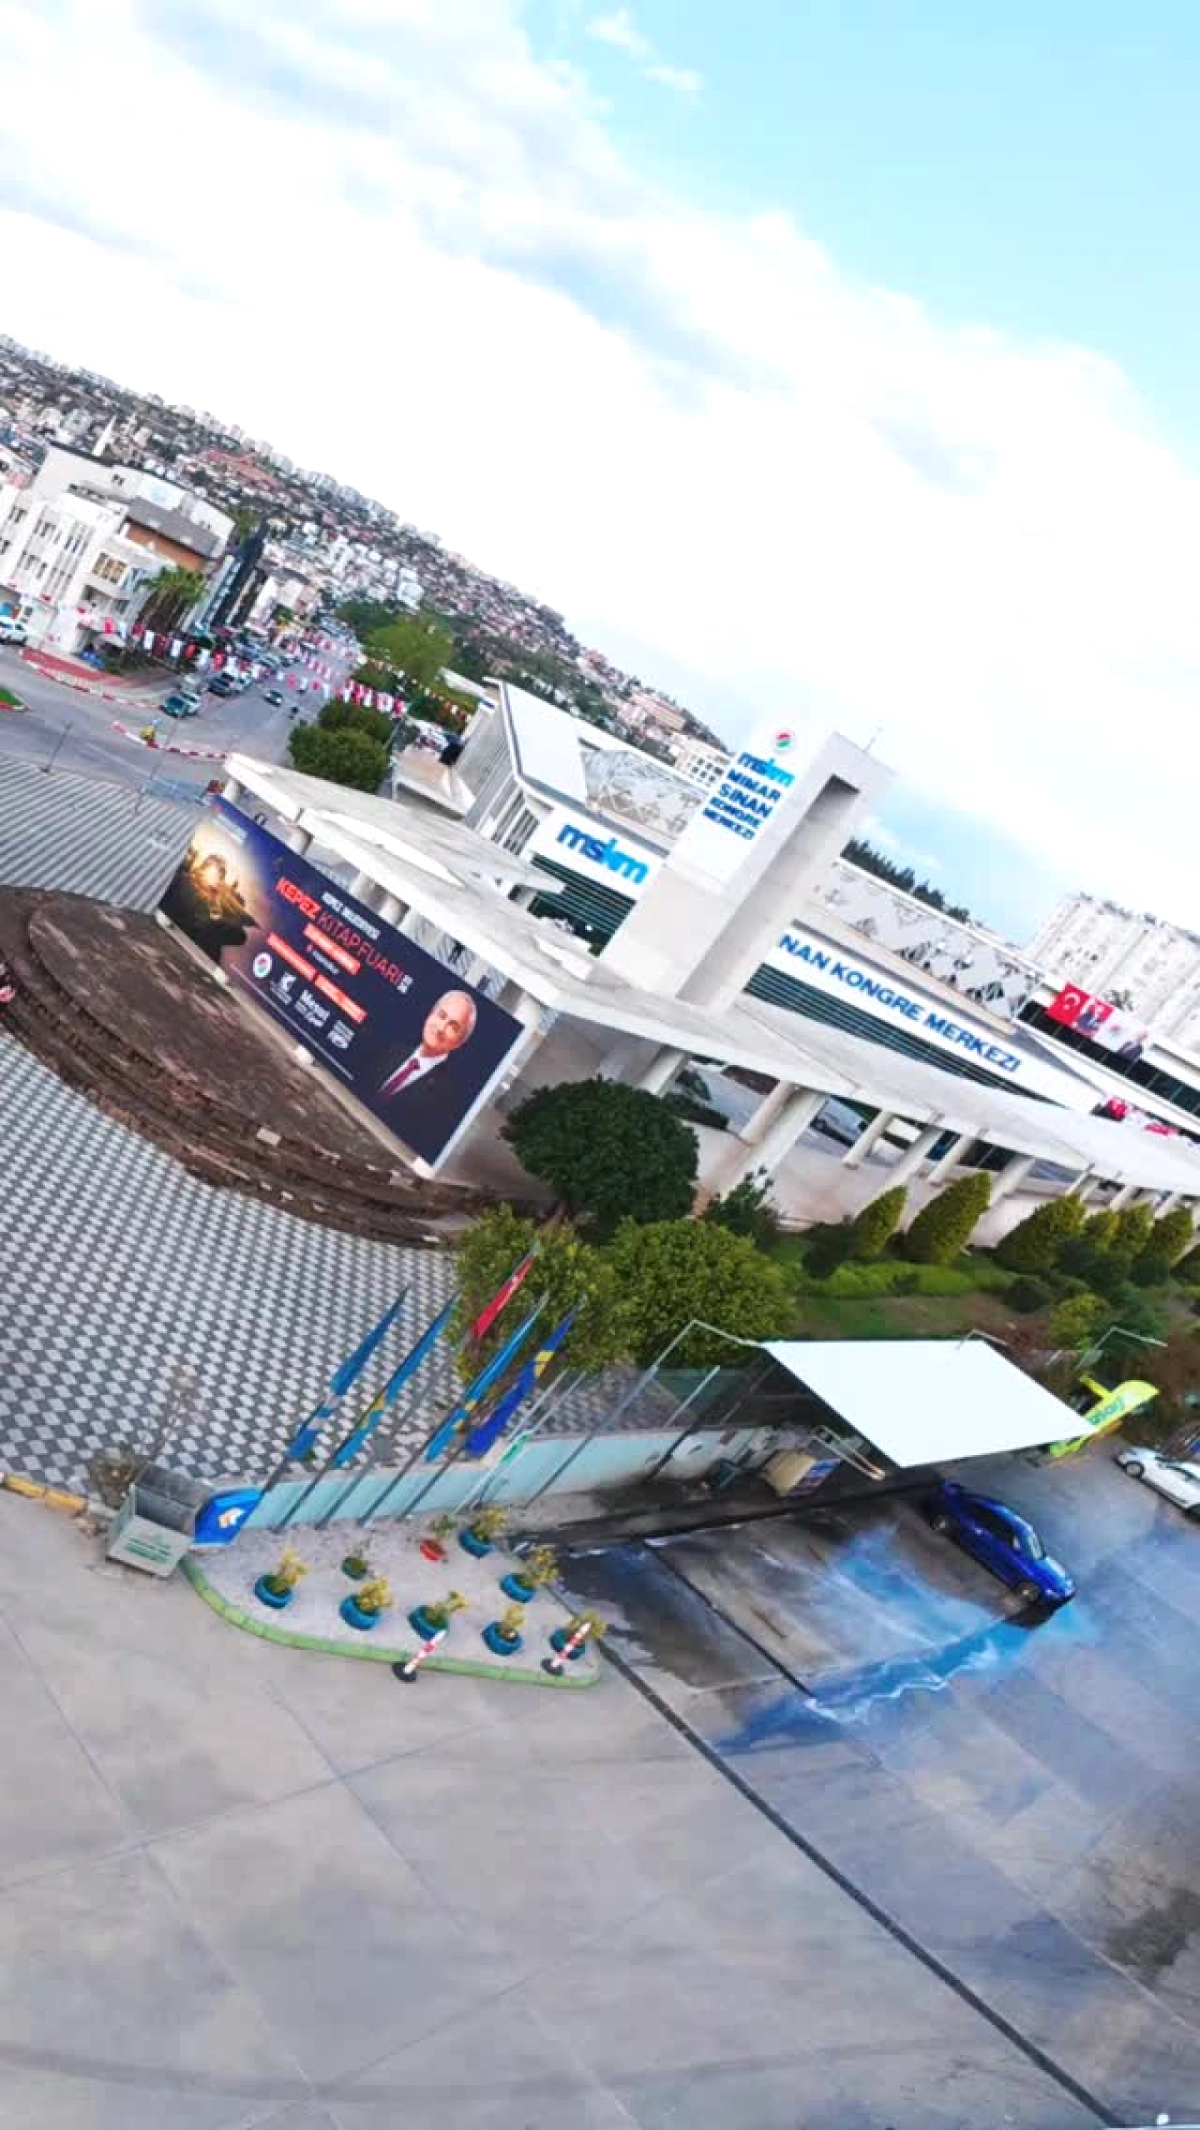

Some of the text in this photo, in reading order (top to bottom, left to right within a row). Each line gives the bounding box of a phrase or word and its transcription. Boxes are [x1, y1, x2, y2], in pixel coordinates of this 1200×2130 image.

[556, 824, 649, 885] mskm
[275, 876, 321, 920] KEPEZ
[830, 962, 926, 1021] KONGRE
